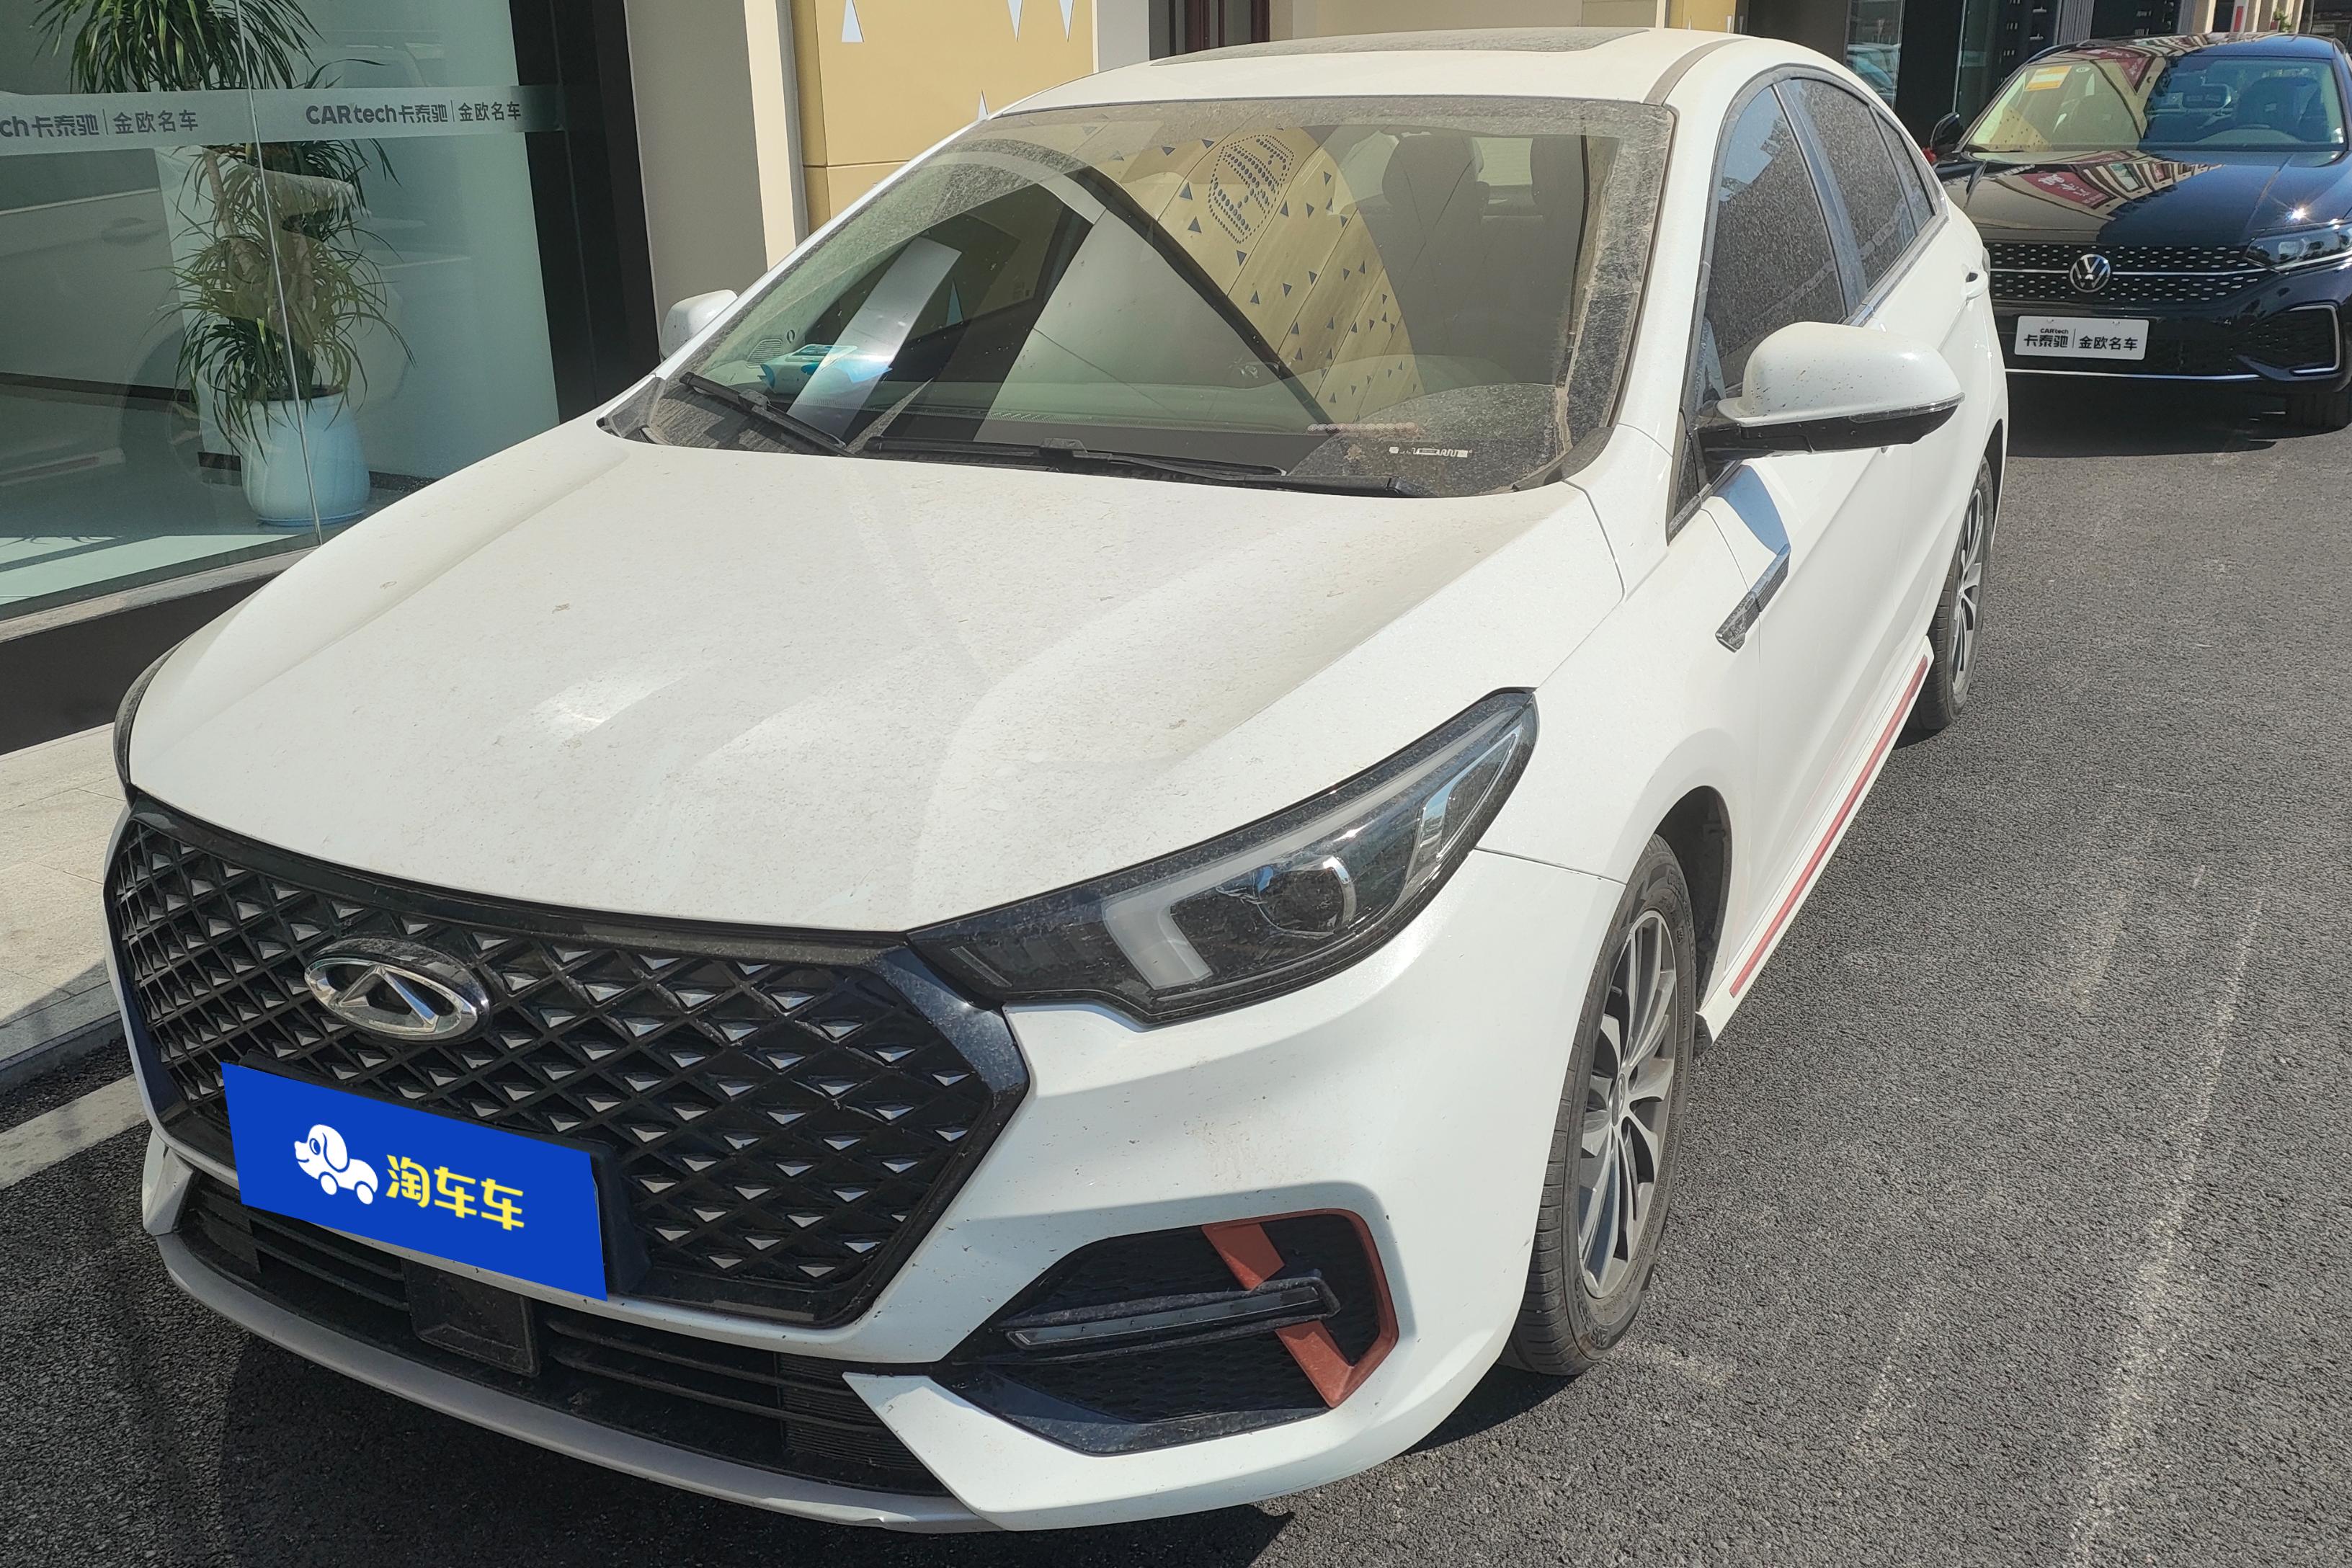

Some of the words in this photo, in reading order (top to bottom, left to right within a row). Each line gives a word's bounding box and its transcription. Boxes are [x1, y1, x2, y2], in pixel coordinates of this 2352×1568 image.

[113, 109, 198, 135] 金欧名车
[458, 101, 521, 122] 金欧名车
[2023, 334, 2069, 348] 卡泰驰
[2078, 336, 2138, 351] 金欧名车
